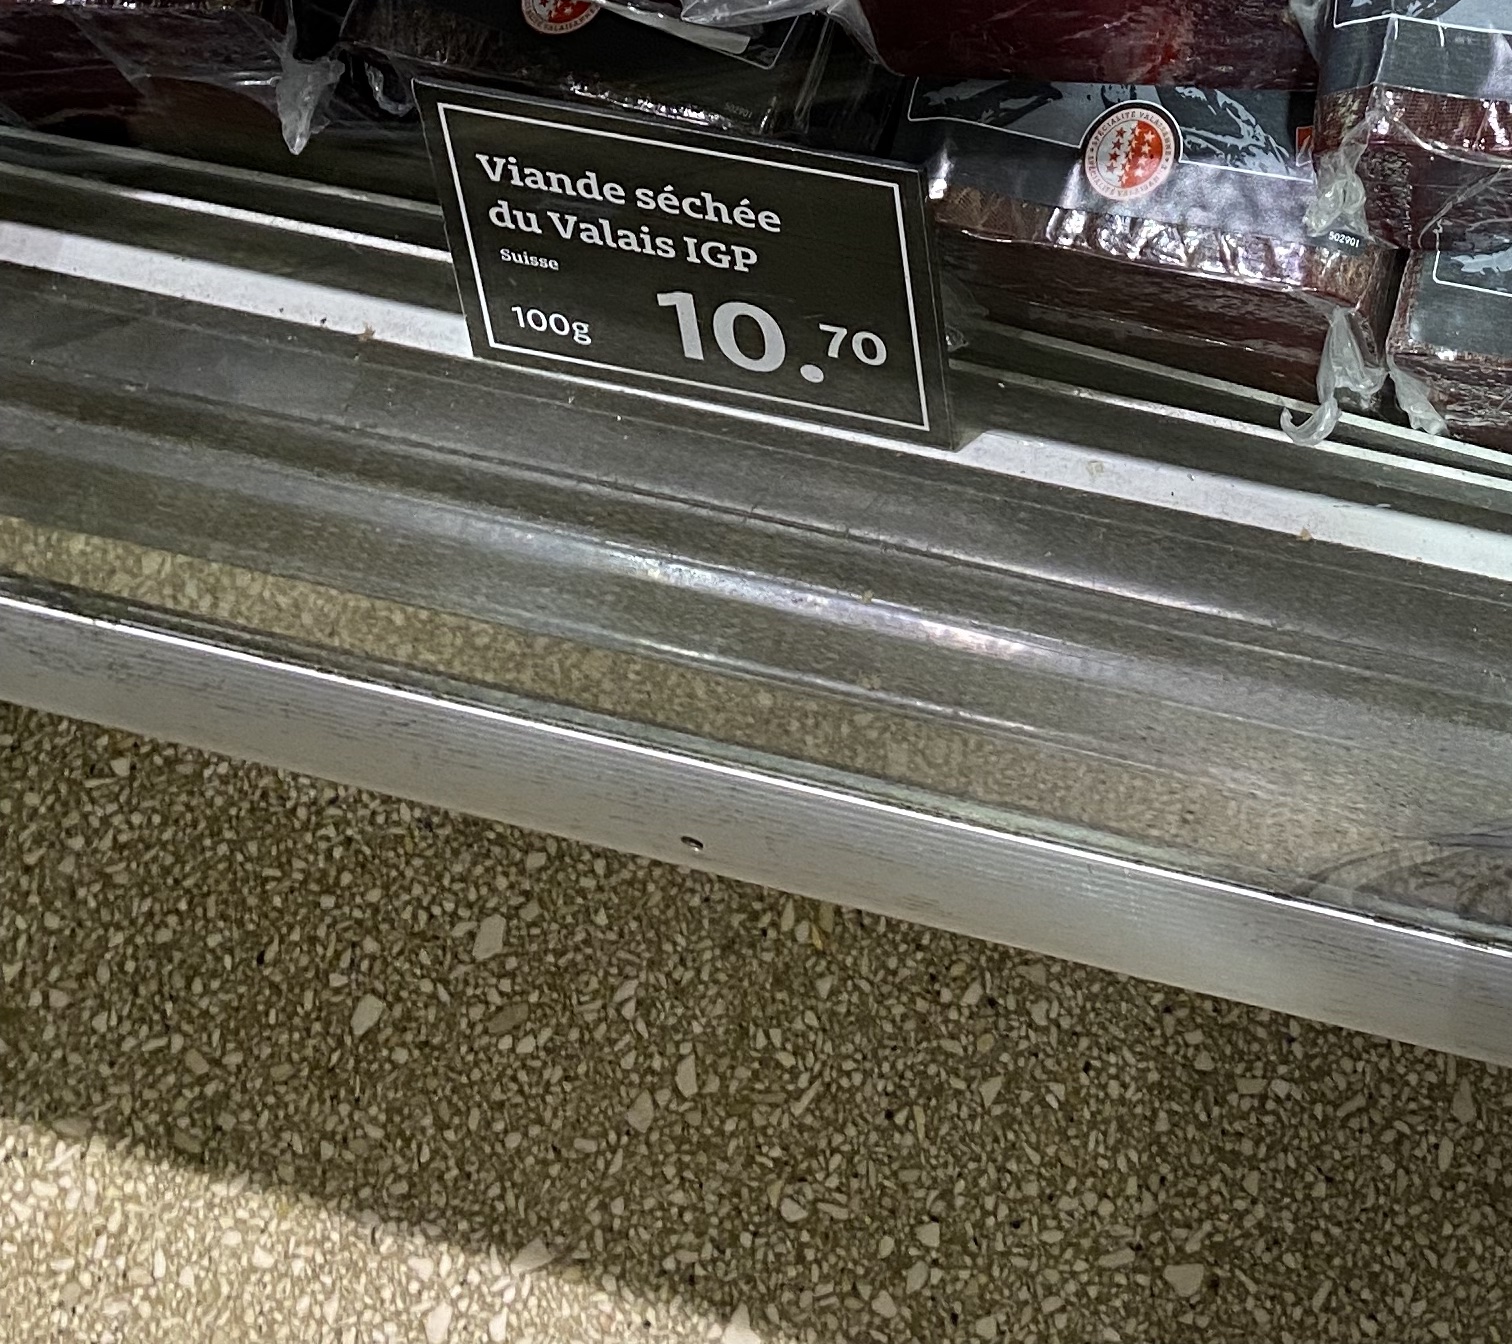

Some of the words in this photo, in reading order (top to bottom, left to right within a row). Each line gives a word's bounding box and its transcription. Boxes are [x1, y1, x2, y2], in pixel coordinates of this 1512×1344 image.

[475, 153, 626, 205] Viande
[635, 183, 782, 233] séchée
[489, 200, 542, 234] du
[546, 211, 676, 259] Valais
[682, 235, 759, 274] IGP
[1328, 230, 1360, 248] 502901
[499, 248, 560, 271] Suisse
[511, 305, 592, 346] 100g
